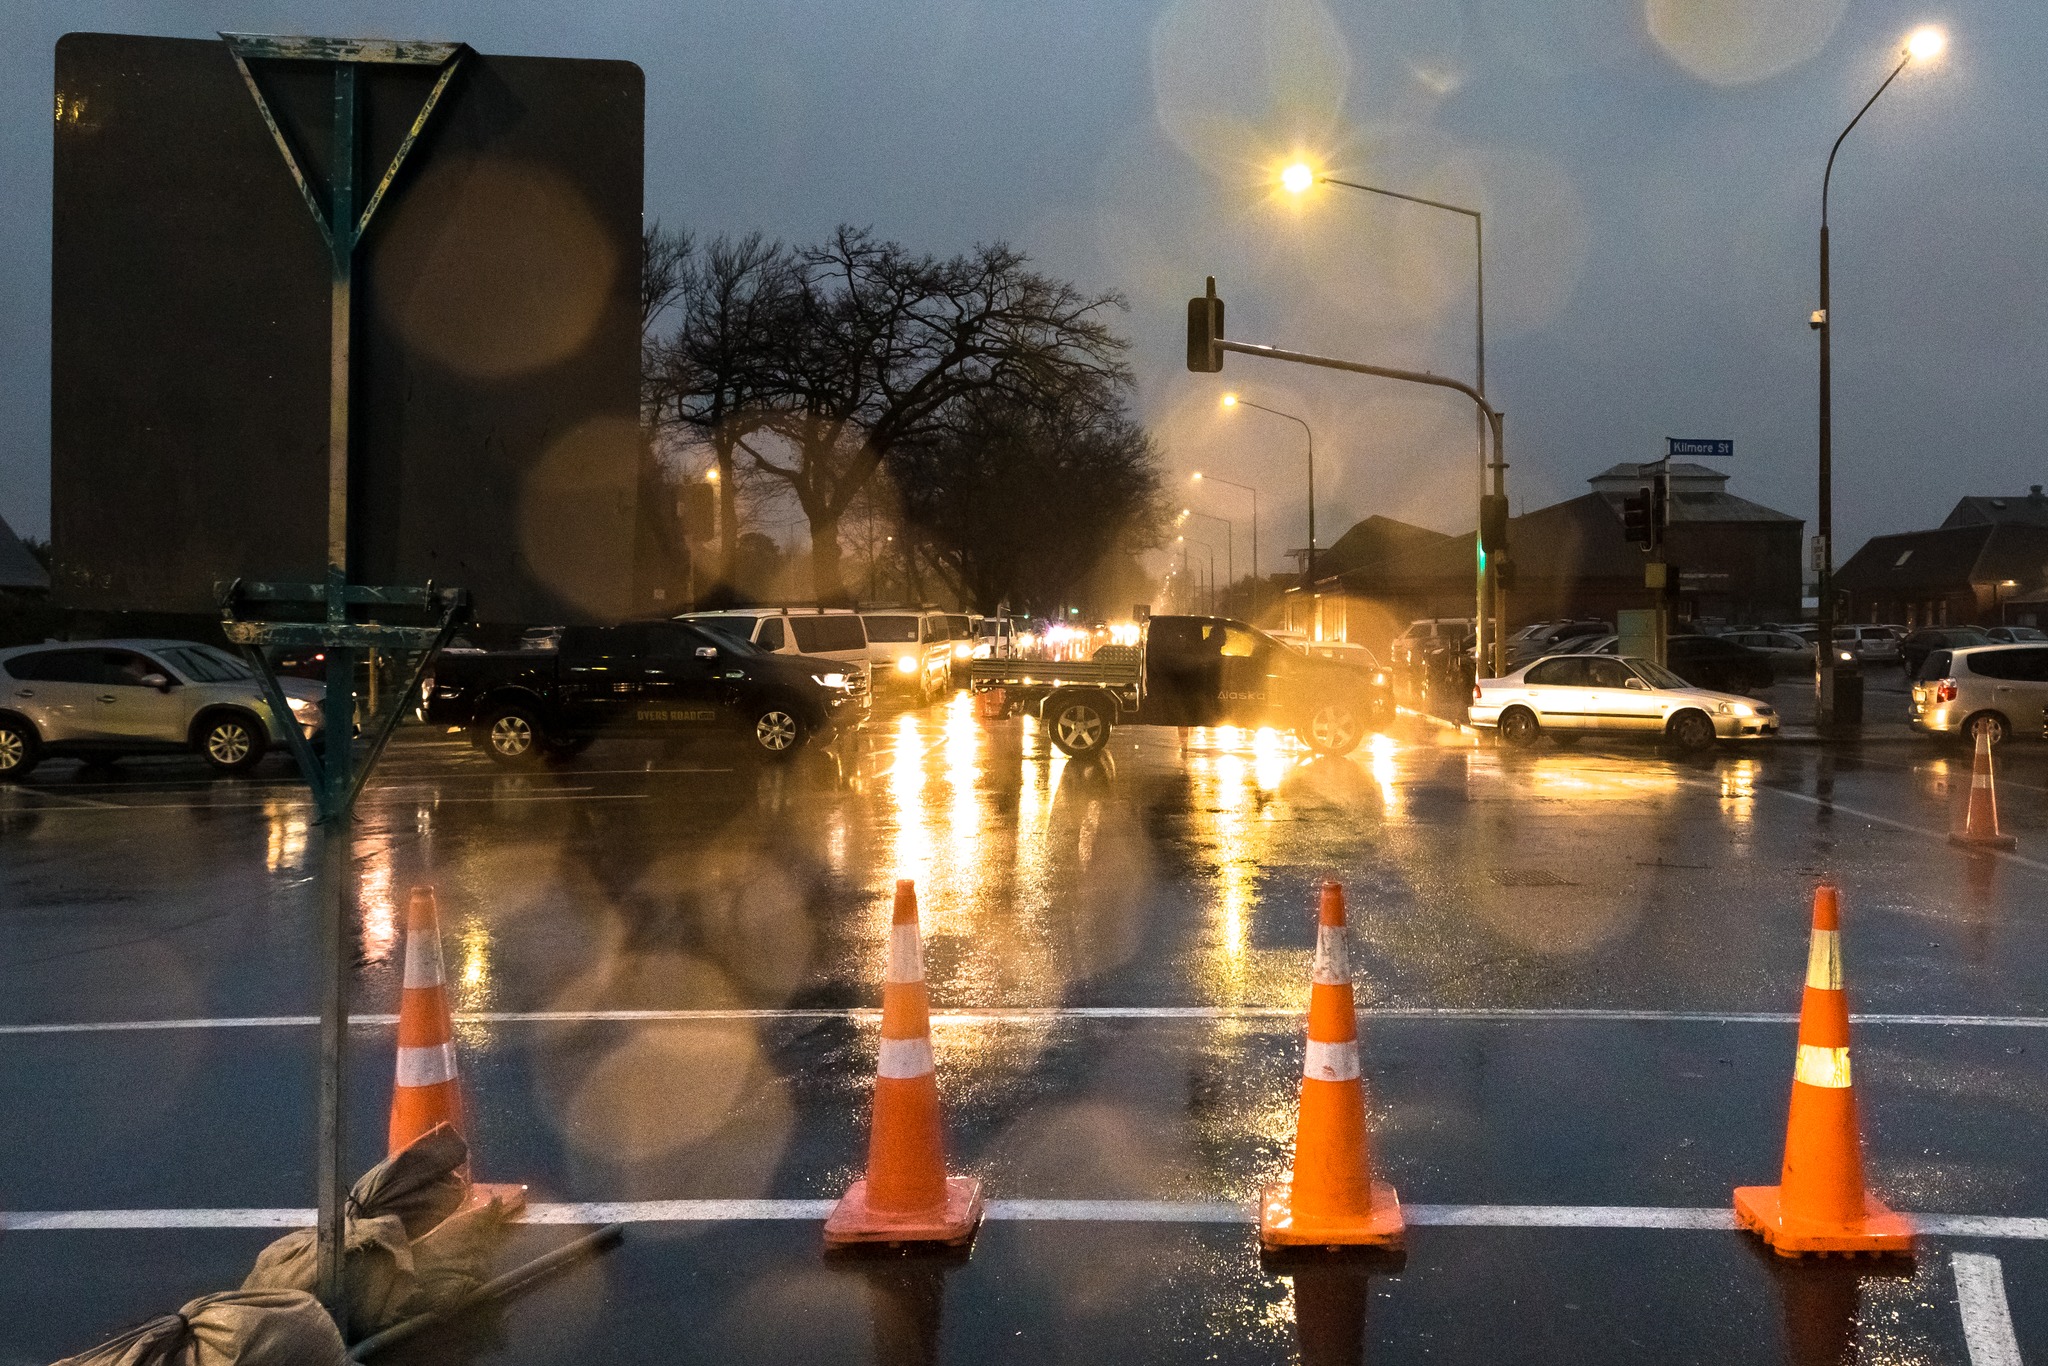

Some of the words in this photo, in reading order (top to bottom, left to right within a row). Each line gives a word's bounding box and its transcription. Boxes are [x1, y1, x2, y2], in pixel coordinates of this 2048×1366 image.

[1673, 442, 1713, 453] Kilmore
[1718, 443, 1729, 453] St
[1218, 691, 1265, 700] Alaska
[637, 711, 668, 720] DYERS
[670, 711, 697, 720] ROAD
